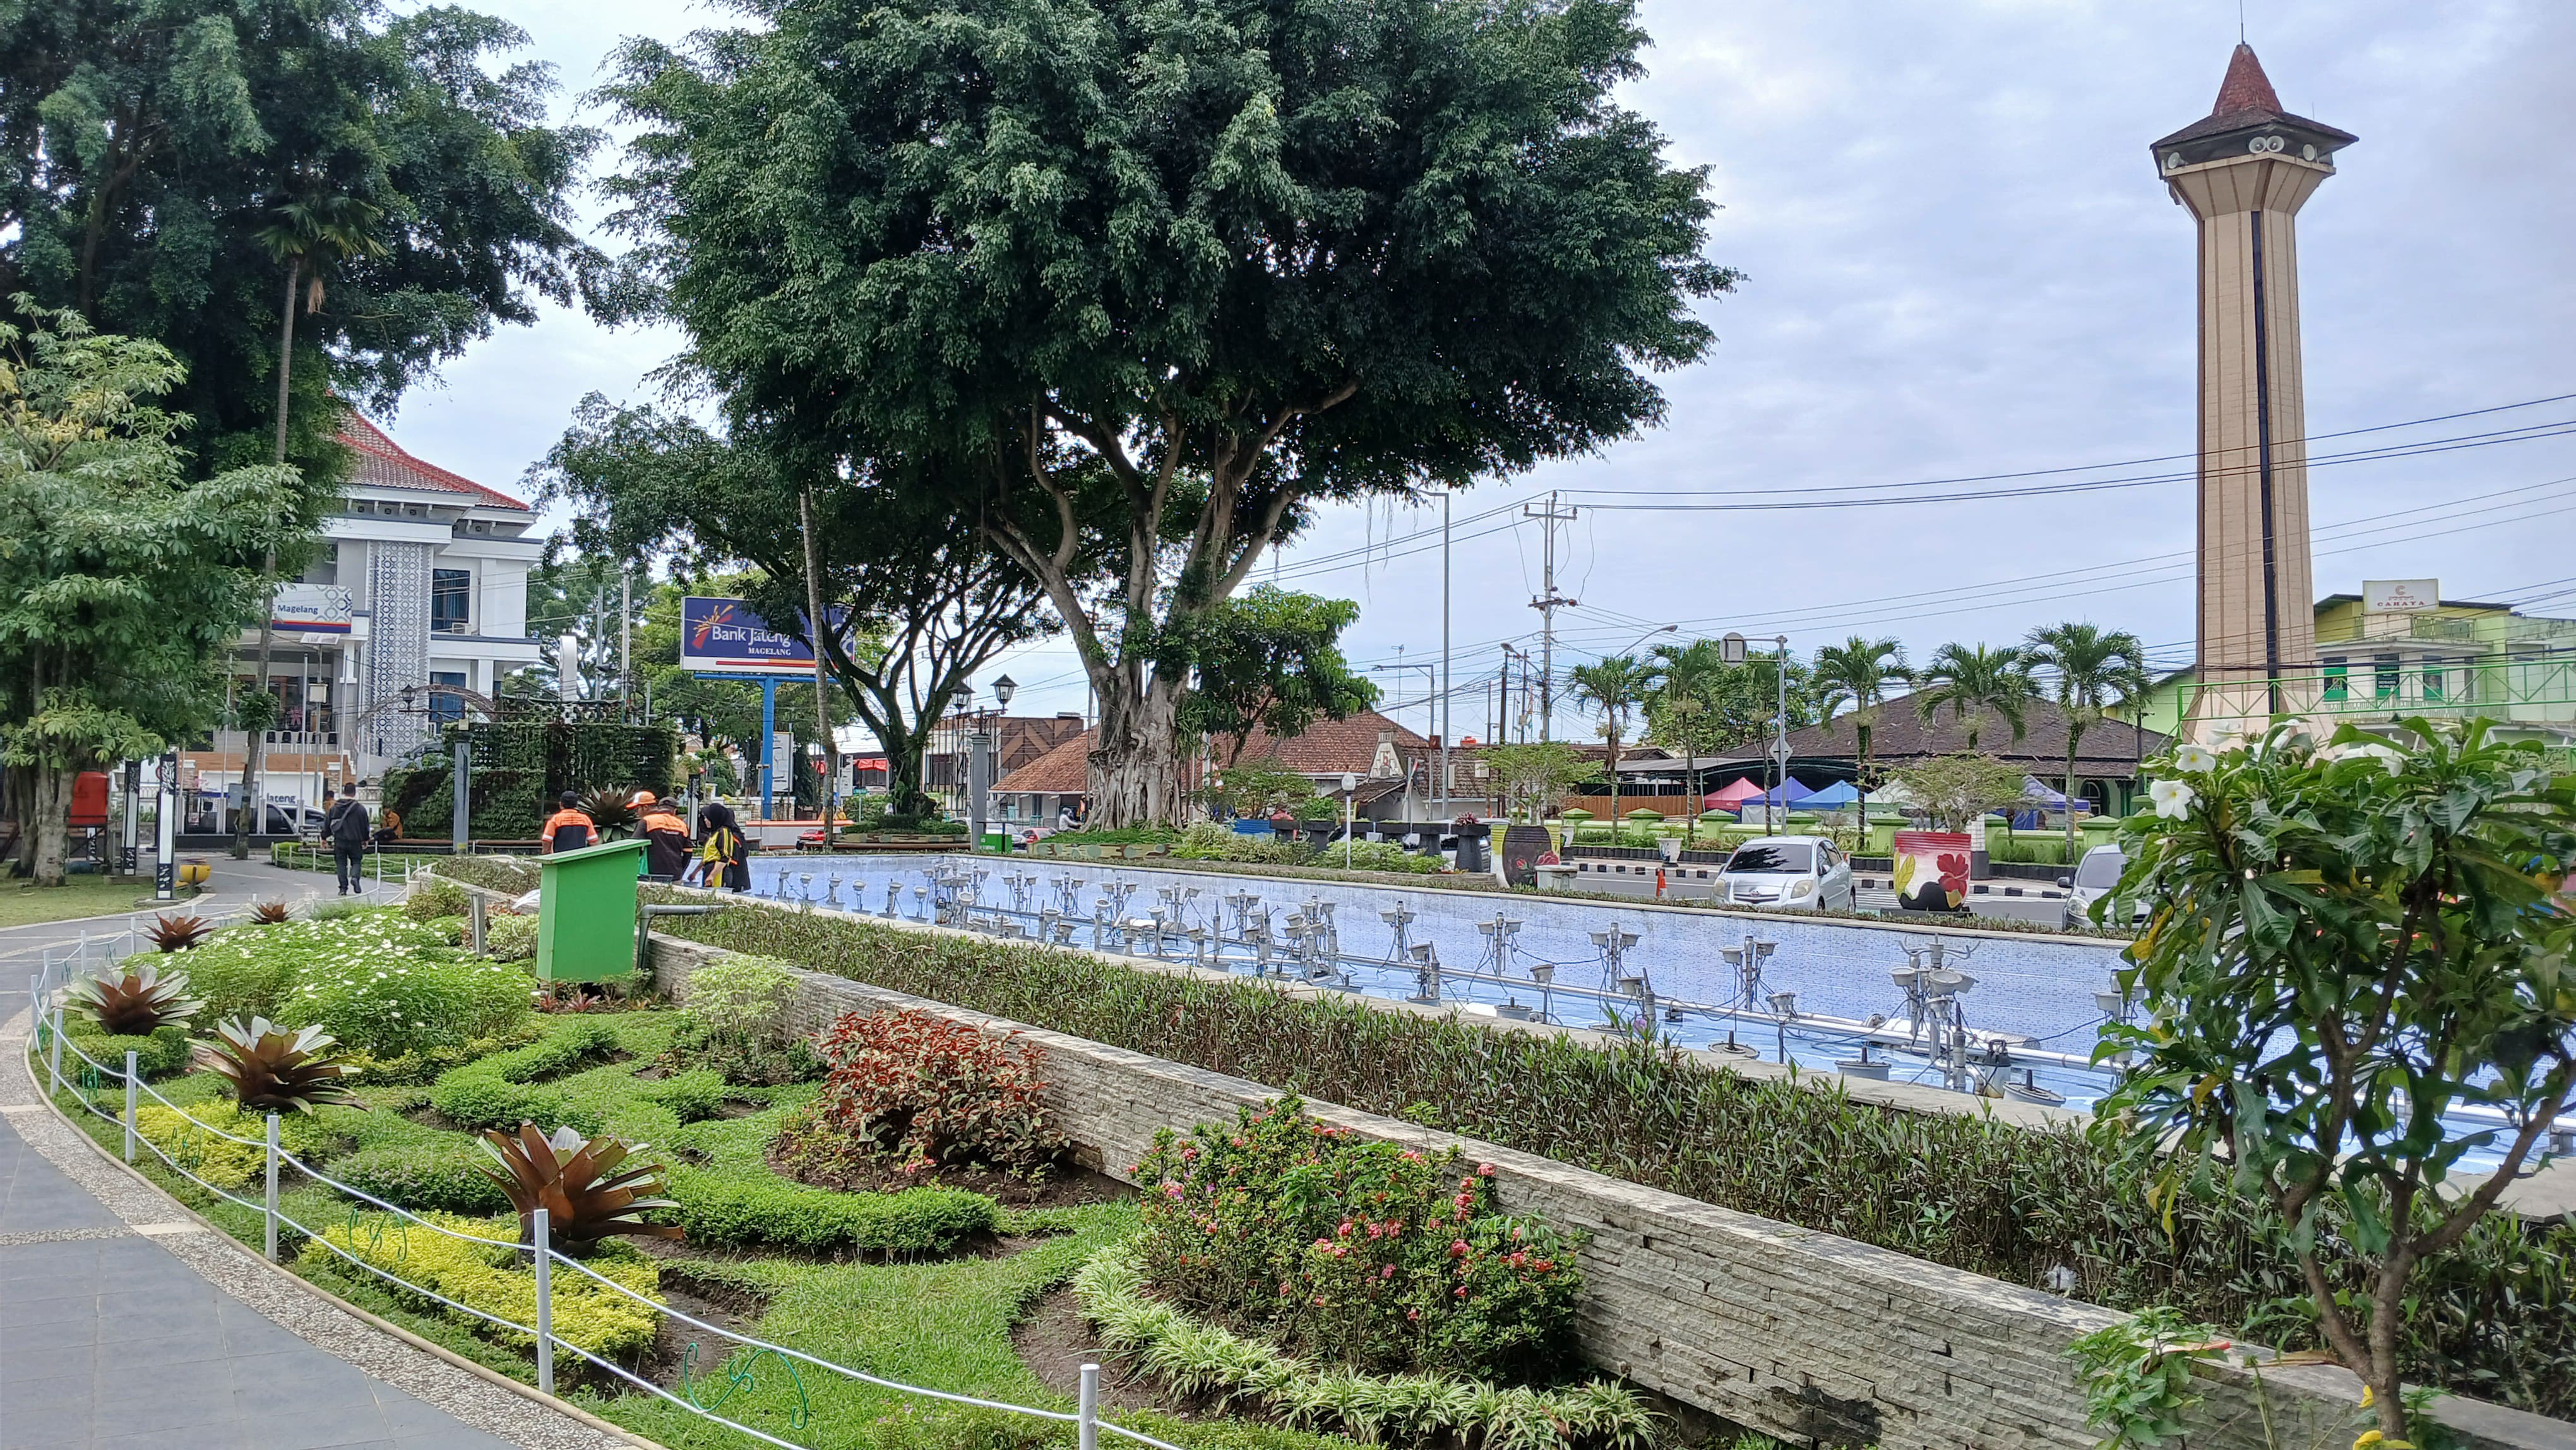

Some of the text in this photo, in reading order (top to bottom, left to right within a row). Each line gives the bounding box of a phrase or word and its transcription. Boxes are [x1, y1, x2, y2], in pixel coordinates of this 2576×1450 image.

[278, 605, 318, 614] Magelang
[712, 626, 791, 647] Bank Jateng
[748, 647, 791, 656] MAGELANG
